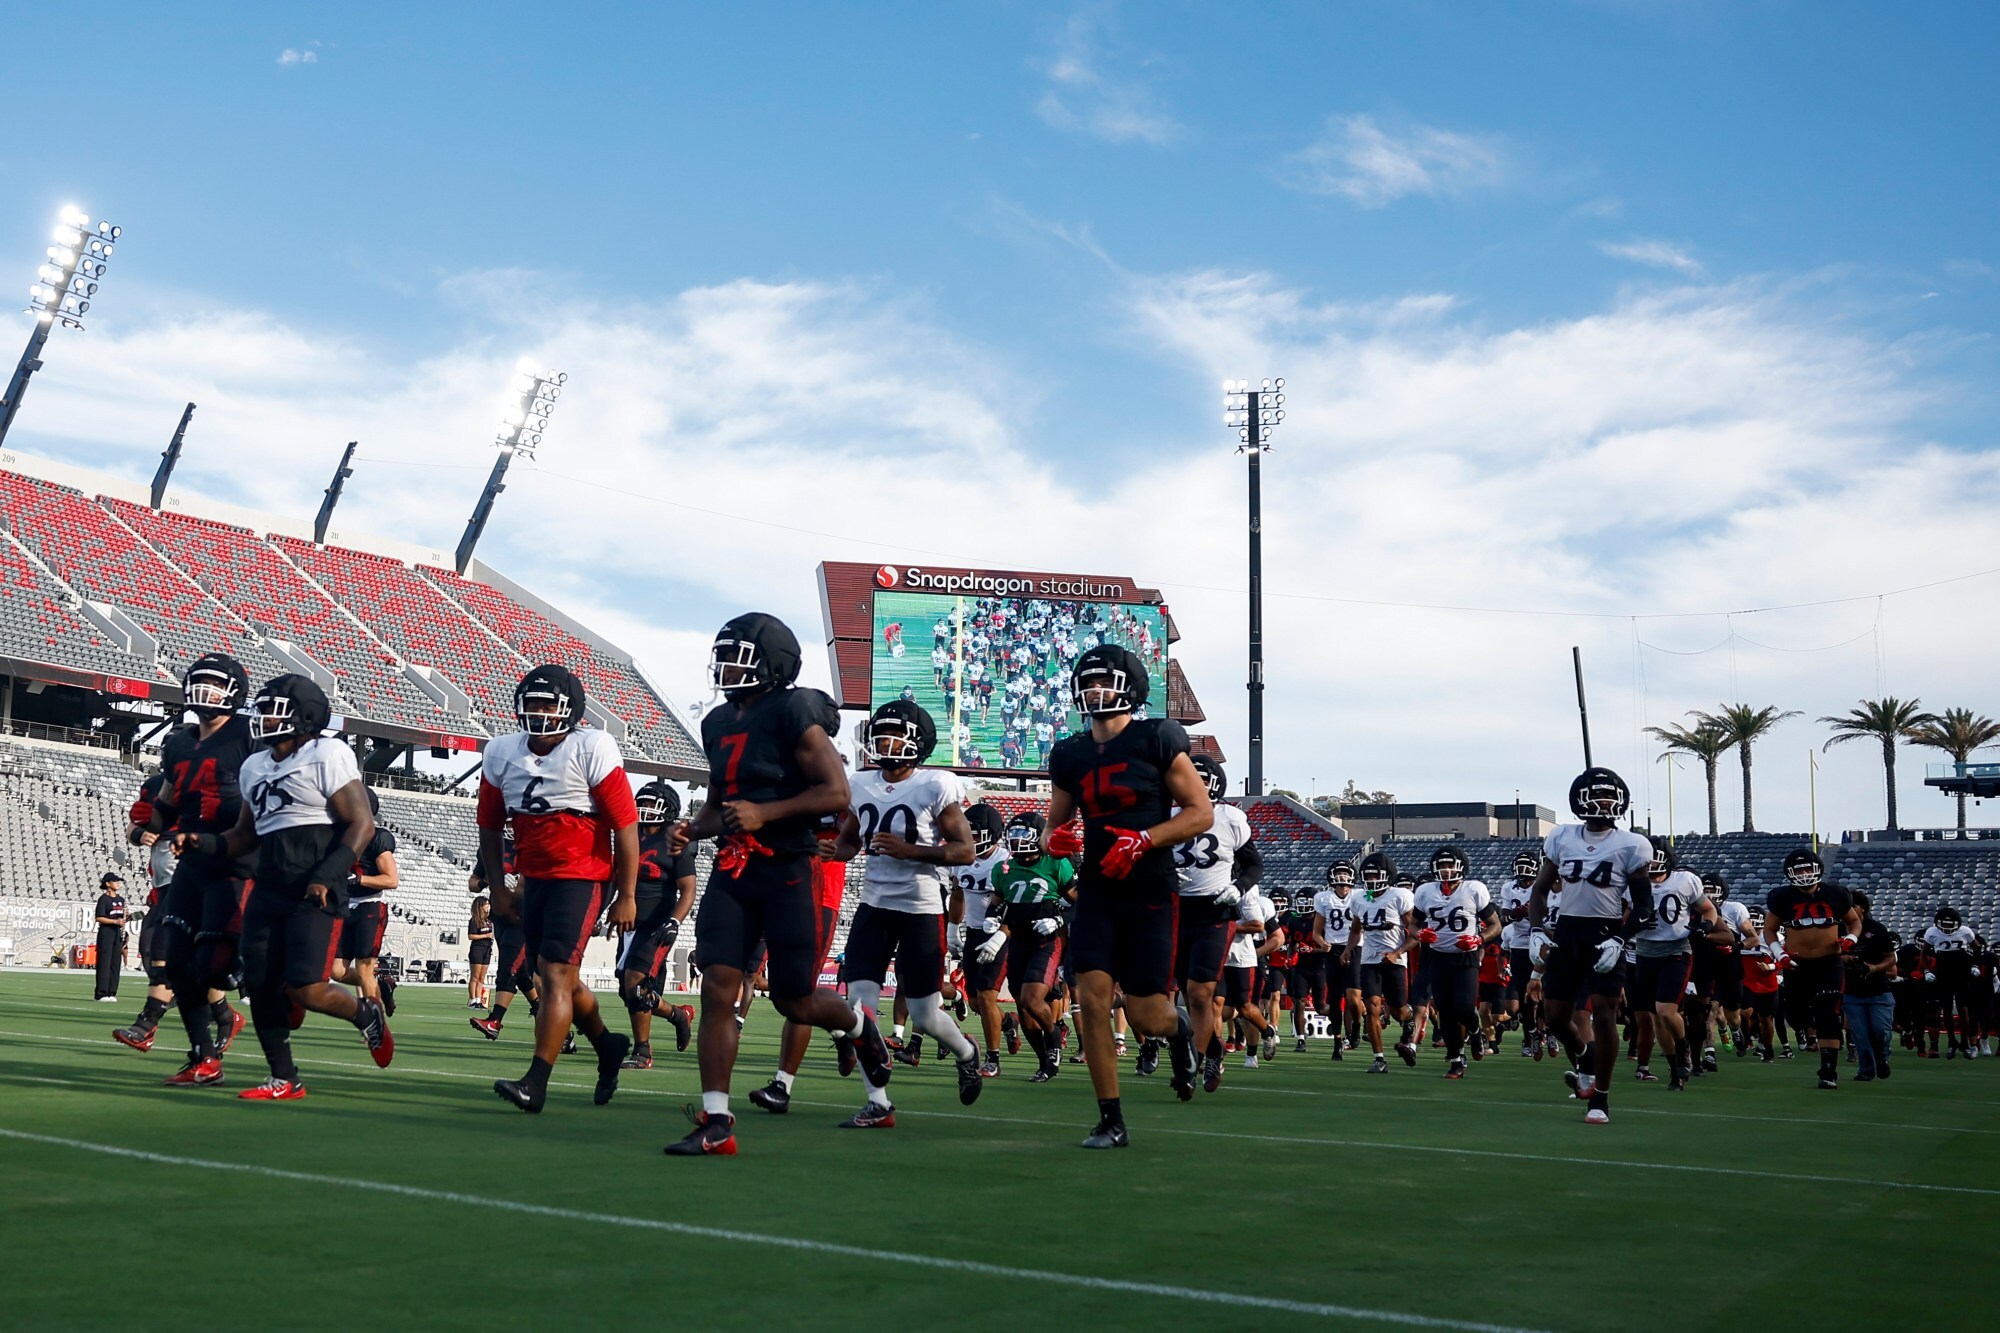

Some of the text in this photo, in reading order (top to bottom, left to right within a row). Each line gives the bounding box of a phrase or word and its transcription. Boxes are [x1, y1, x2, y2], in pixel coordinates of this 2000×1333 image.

[2, 454, 16, 463] 209
[169, 497, 180, 506] 210
[906, 568, 1123, 598] Snapdragon stadium
[719, 732, 749, 797] 7
[522, 776, 550, 813] 6
[1079, 762, 1138, 818] 15
[858, 802, 919, 856] 20
[12, 919, 54, 930] stadium
[1428, 905, 1469, 932] 56
